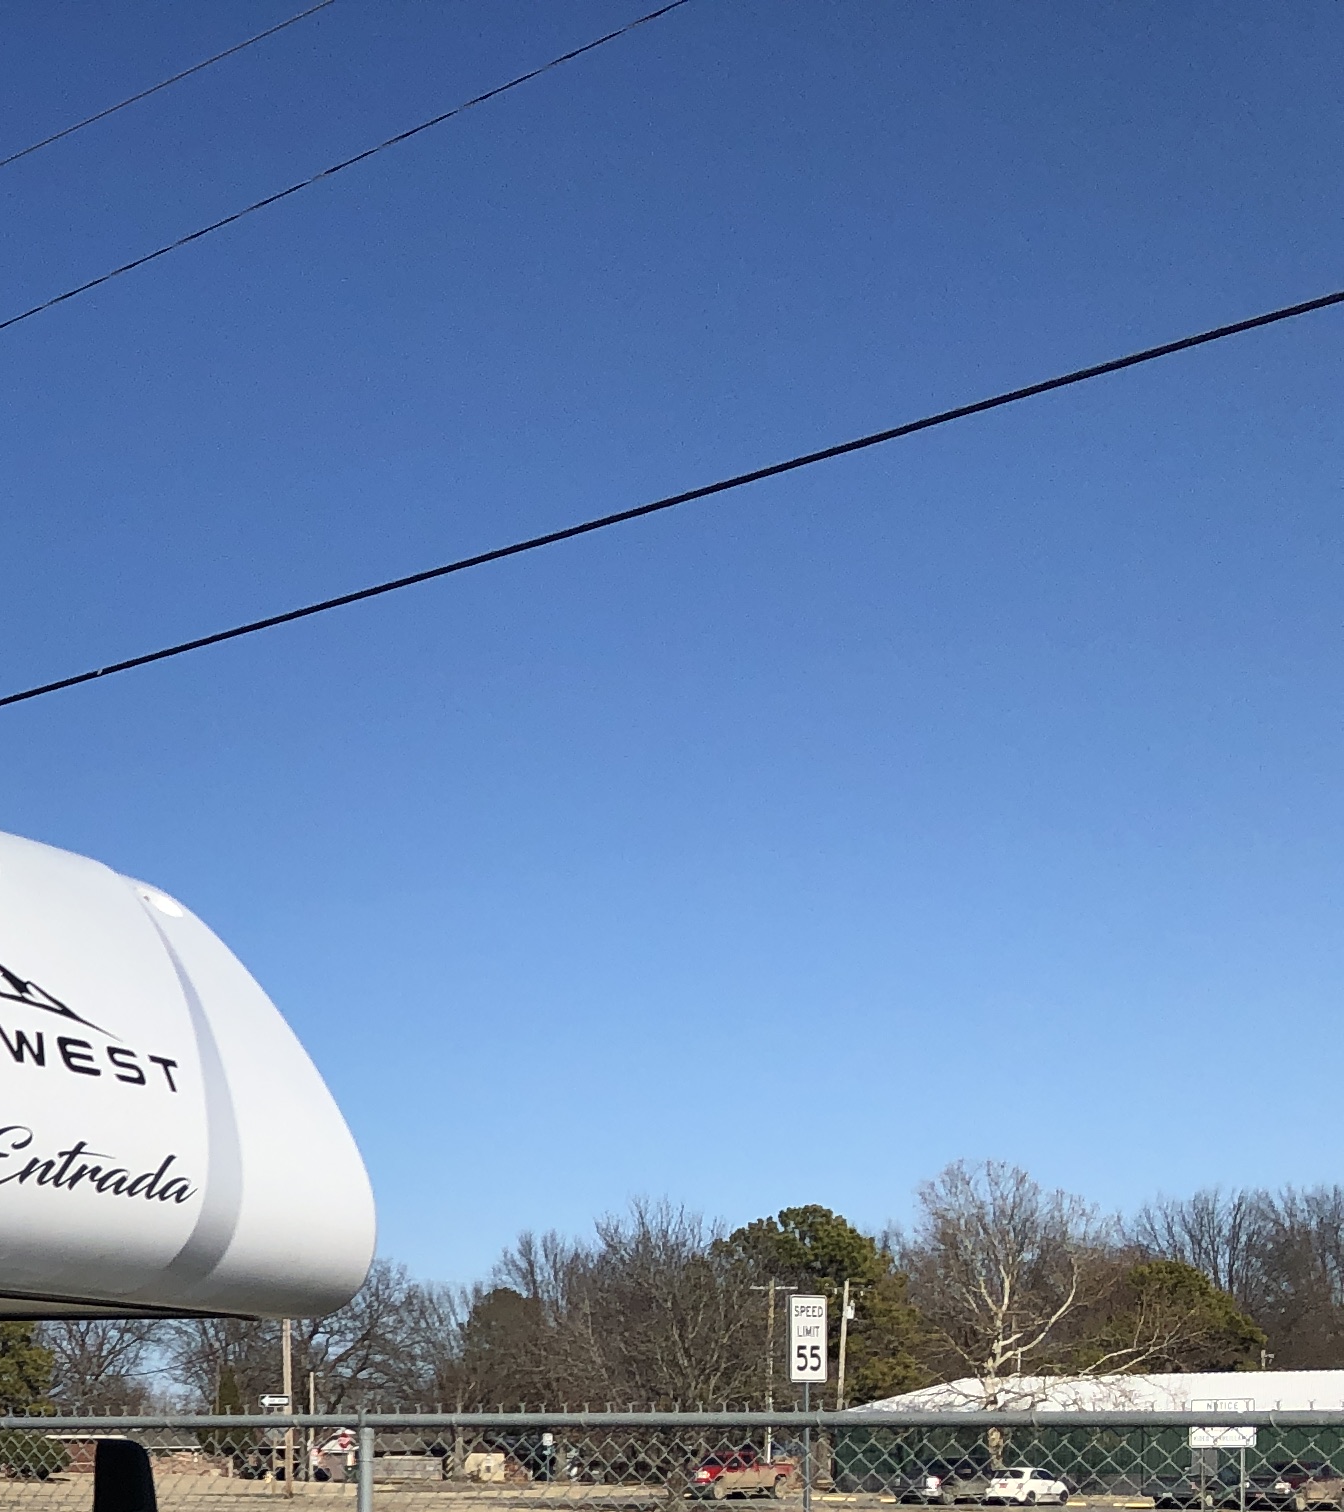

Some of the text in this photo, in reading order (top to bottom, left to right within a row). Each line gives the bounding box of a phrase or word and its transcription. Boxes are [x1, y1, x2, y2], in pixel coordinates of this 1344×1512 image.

[794, 1305, 824, 1318] SPEED
[796, 1325, 820, 1338] LIMIT
[796, 1345, 822, 1372] 55
